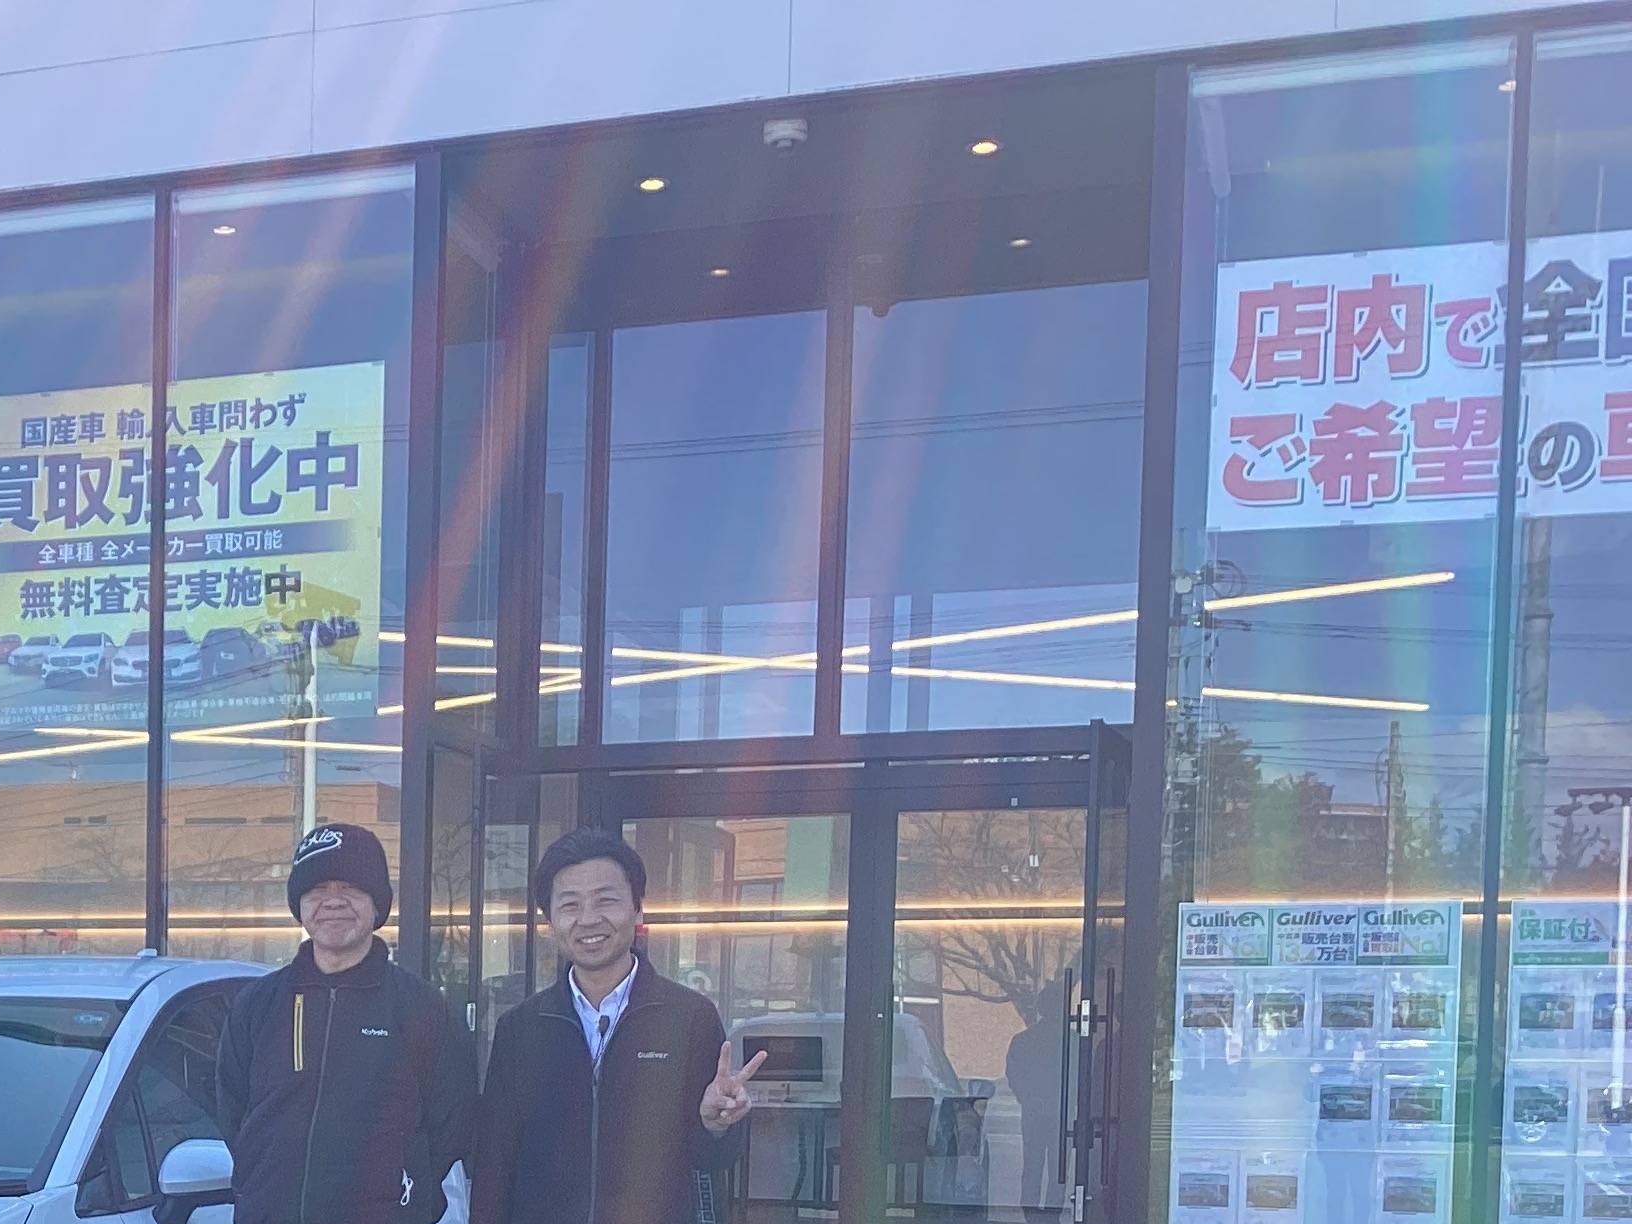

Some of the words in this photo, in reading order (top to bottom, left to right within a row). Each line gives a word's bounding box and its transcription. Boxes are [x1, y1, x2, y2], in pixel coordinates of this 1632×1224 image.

[1229, 257, 1632, 388] 店内で全
[21, 411, 105, 449] 国産車
[116, 392, 307, 440] 輸入車問わず
[38, 541, 94, 565] 全車種
[20, 563, 303, 620] 無料査定実施中
[1186, 910, 1265, 928] Gulliver
[1276, 910, 1357, 926] Gulliver
[1364, 908, 1446, 926] Gulliver
